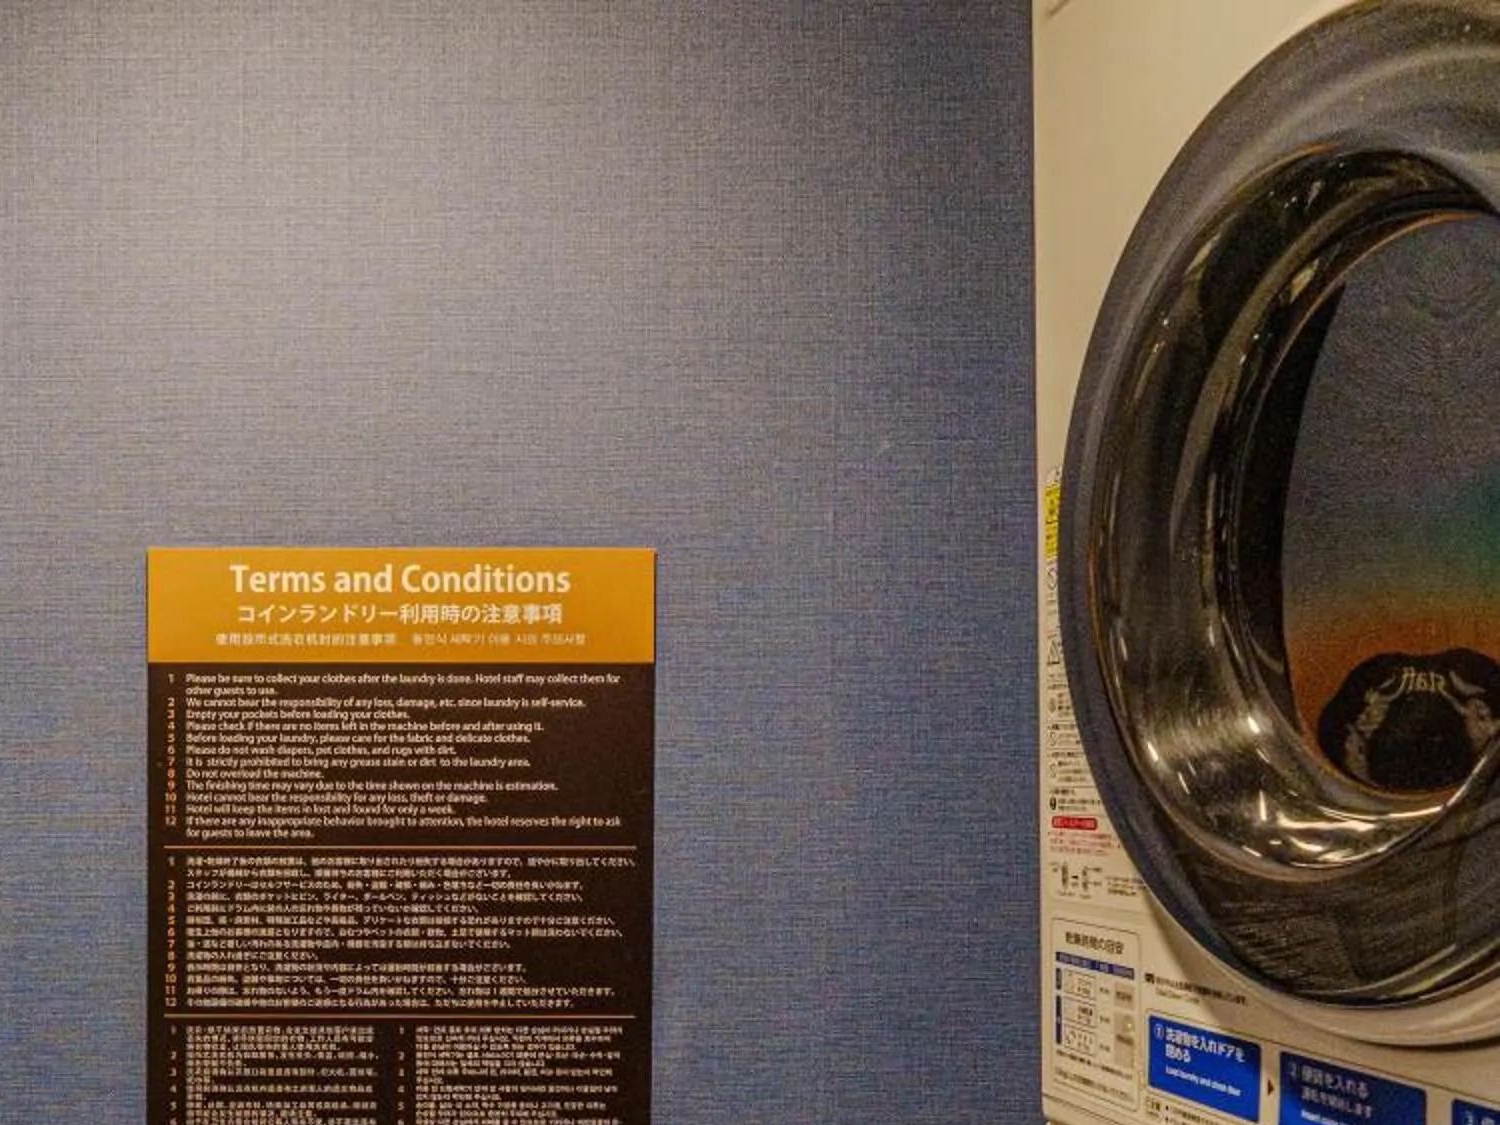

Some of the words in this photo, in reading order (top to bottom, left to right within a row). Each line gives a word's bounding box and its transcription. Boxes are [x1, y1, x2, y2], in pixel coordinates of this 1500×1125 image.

[230, 564, 326, 594] Terms
[334, 564, 392, 594] and
[401, 564, 571, 594] Conditions
[238, 603, 563, 624] コインランドリー利用時の注意事項
